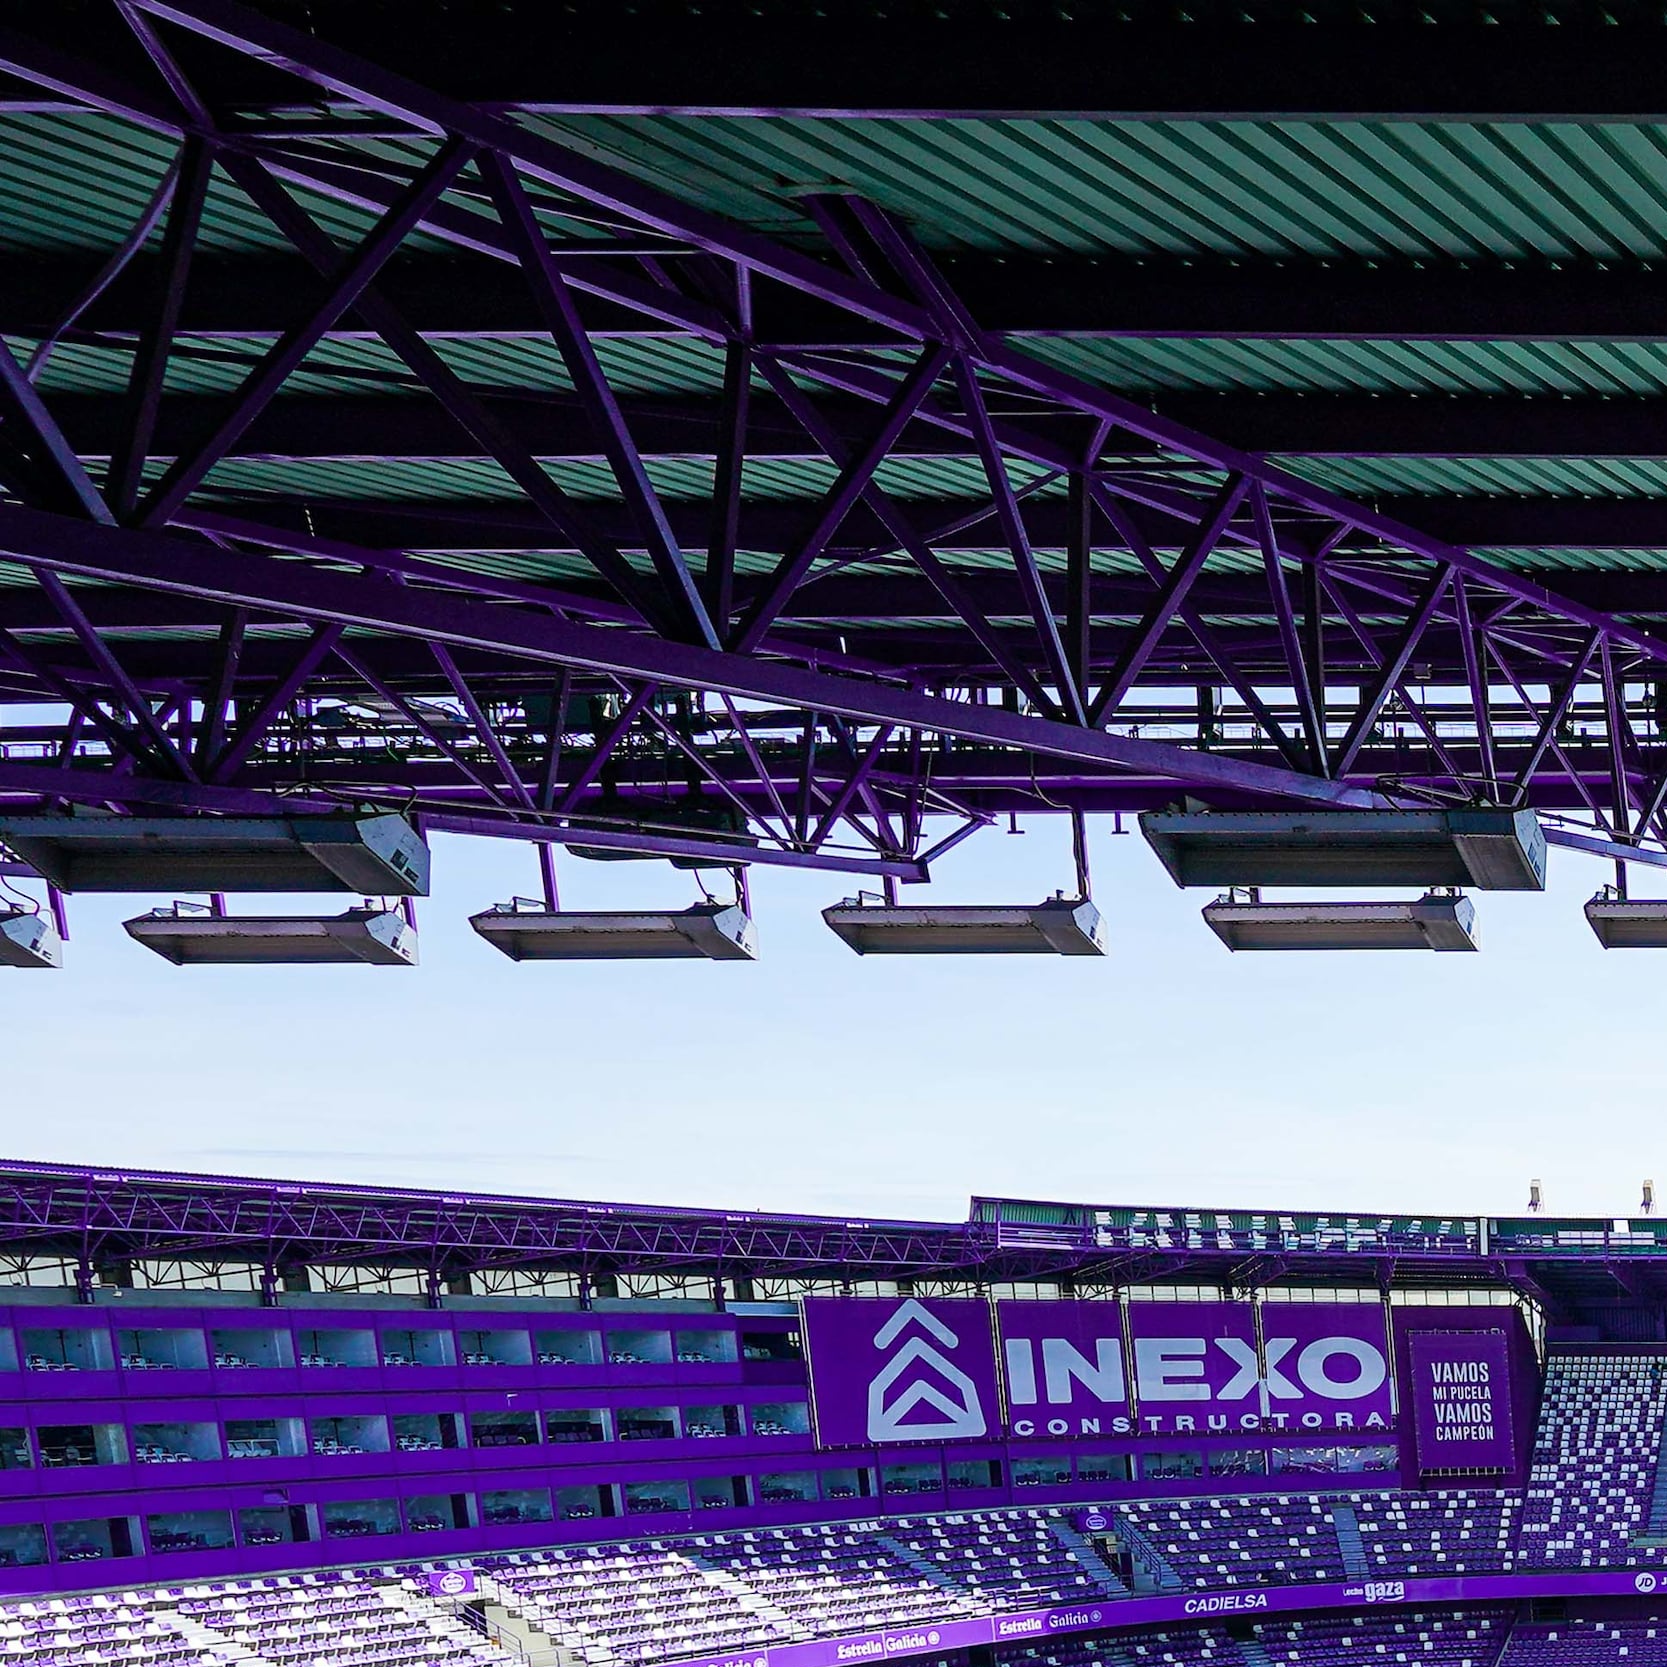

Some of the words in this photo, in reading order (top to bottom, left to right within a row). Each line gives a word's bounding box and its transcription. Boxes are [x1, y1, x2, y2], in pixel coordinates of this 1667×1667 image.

[1005, 1336, 1386, 1405] INEXO
[1431, 1362, 1490, 1383] VAMOS
[1432, 1386, 1446, 1400] MI
[1450, 1386, 1491, 1400] PUCELA
[1013, 1411, 1385, 1436] CONSTRUCTORA
[1434, 1403, 1491, 1423] VAMOS
[1436, 1424, 1494, 1440] CAMPEÓN
[1364, 1581, 1404, 1602] gaza
[1184, 1594, 1268, 1613] CADIELSA
[999, 1618, 1042, 1635] Estrella
[1048, 1611, 1089, 1628] Galicia
[836, 1641, 882, 1660] Estrella
[885, 1631, 928, 1652] Galicia
